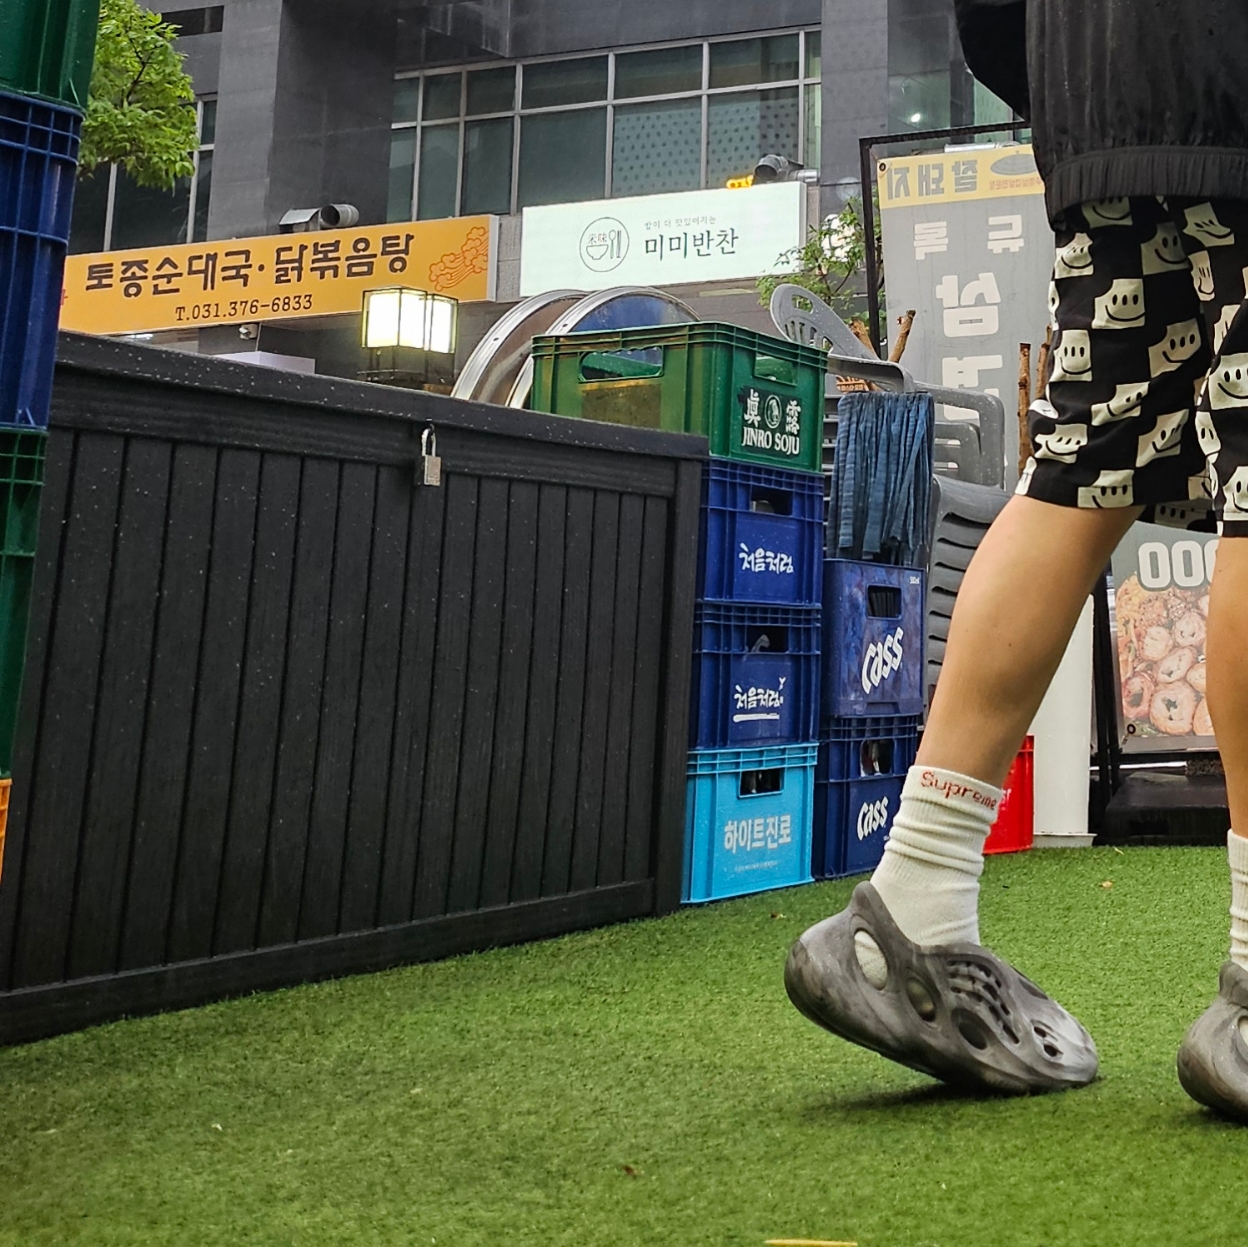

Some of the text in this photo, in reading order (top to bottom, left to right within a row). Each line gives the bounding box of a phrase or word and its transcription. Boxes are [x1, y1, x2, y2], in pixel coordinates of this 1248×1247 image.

[644, 227, 739, 262] 미미반찬
[175, 294, 313, 322] T.031.376-6833
[741, 426, 800, 455] JINRO SOJU
[738, 543, 795, 575] 처음처럼
[733, 684, 784, 710] 처음처럼
[920, 770, 998, 811] Supreme
[723, 813, 793, 853] 하이트진로
